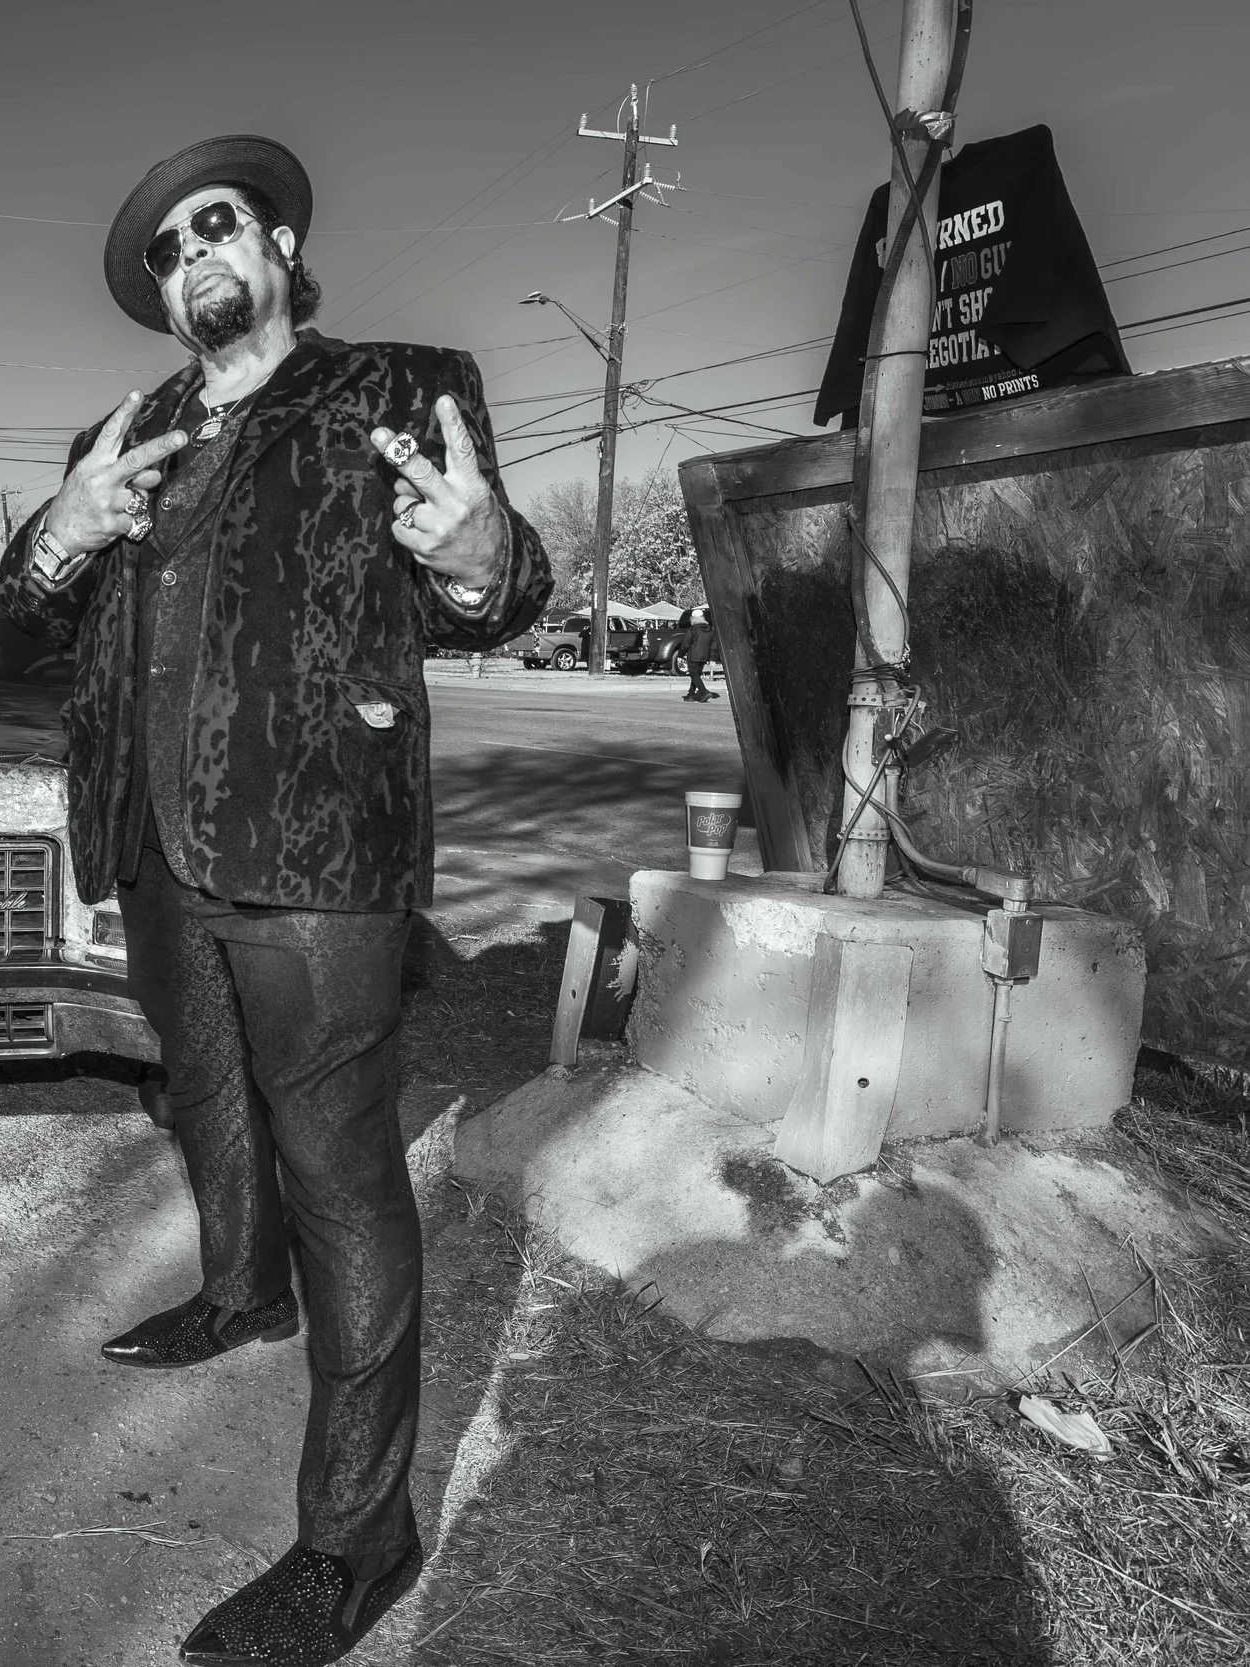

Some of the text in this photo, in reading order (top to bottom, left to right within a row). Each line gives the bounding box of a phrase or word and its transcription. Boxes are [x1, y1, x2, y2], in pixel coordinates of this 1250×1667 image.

[937, 200, 1005, 250] RNED
[981, 241, 1012, 280] GU
[981, 385, 998, 400] NO
[997, 374, 1040, 397] PRINTS
[697, 812, 725, 828] Polar
